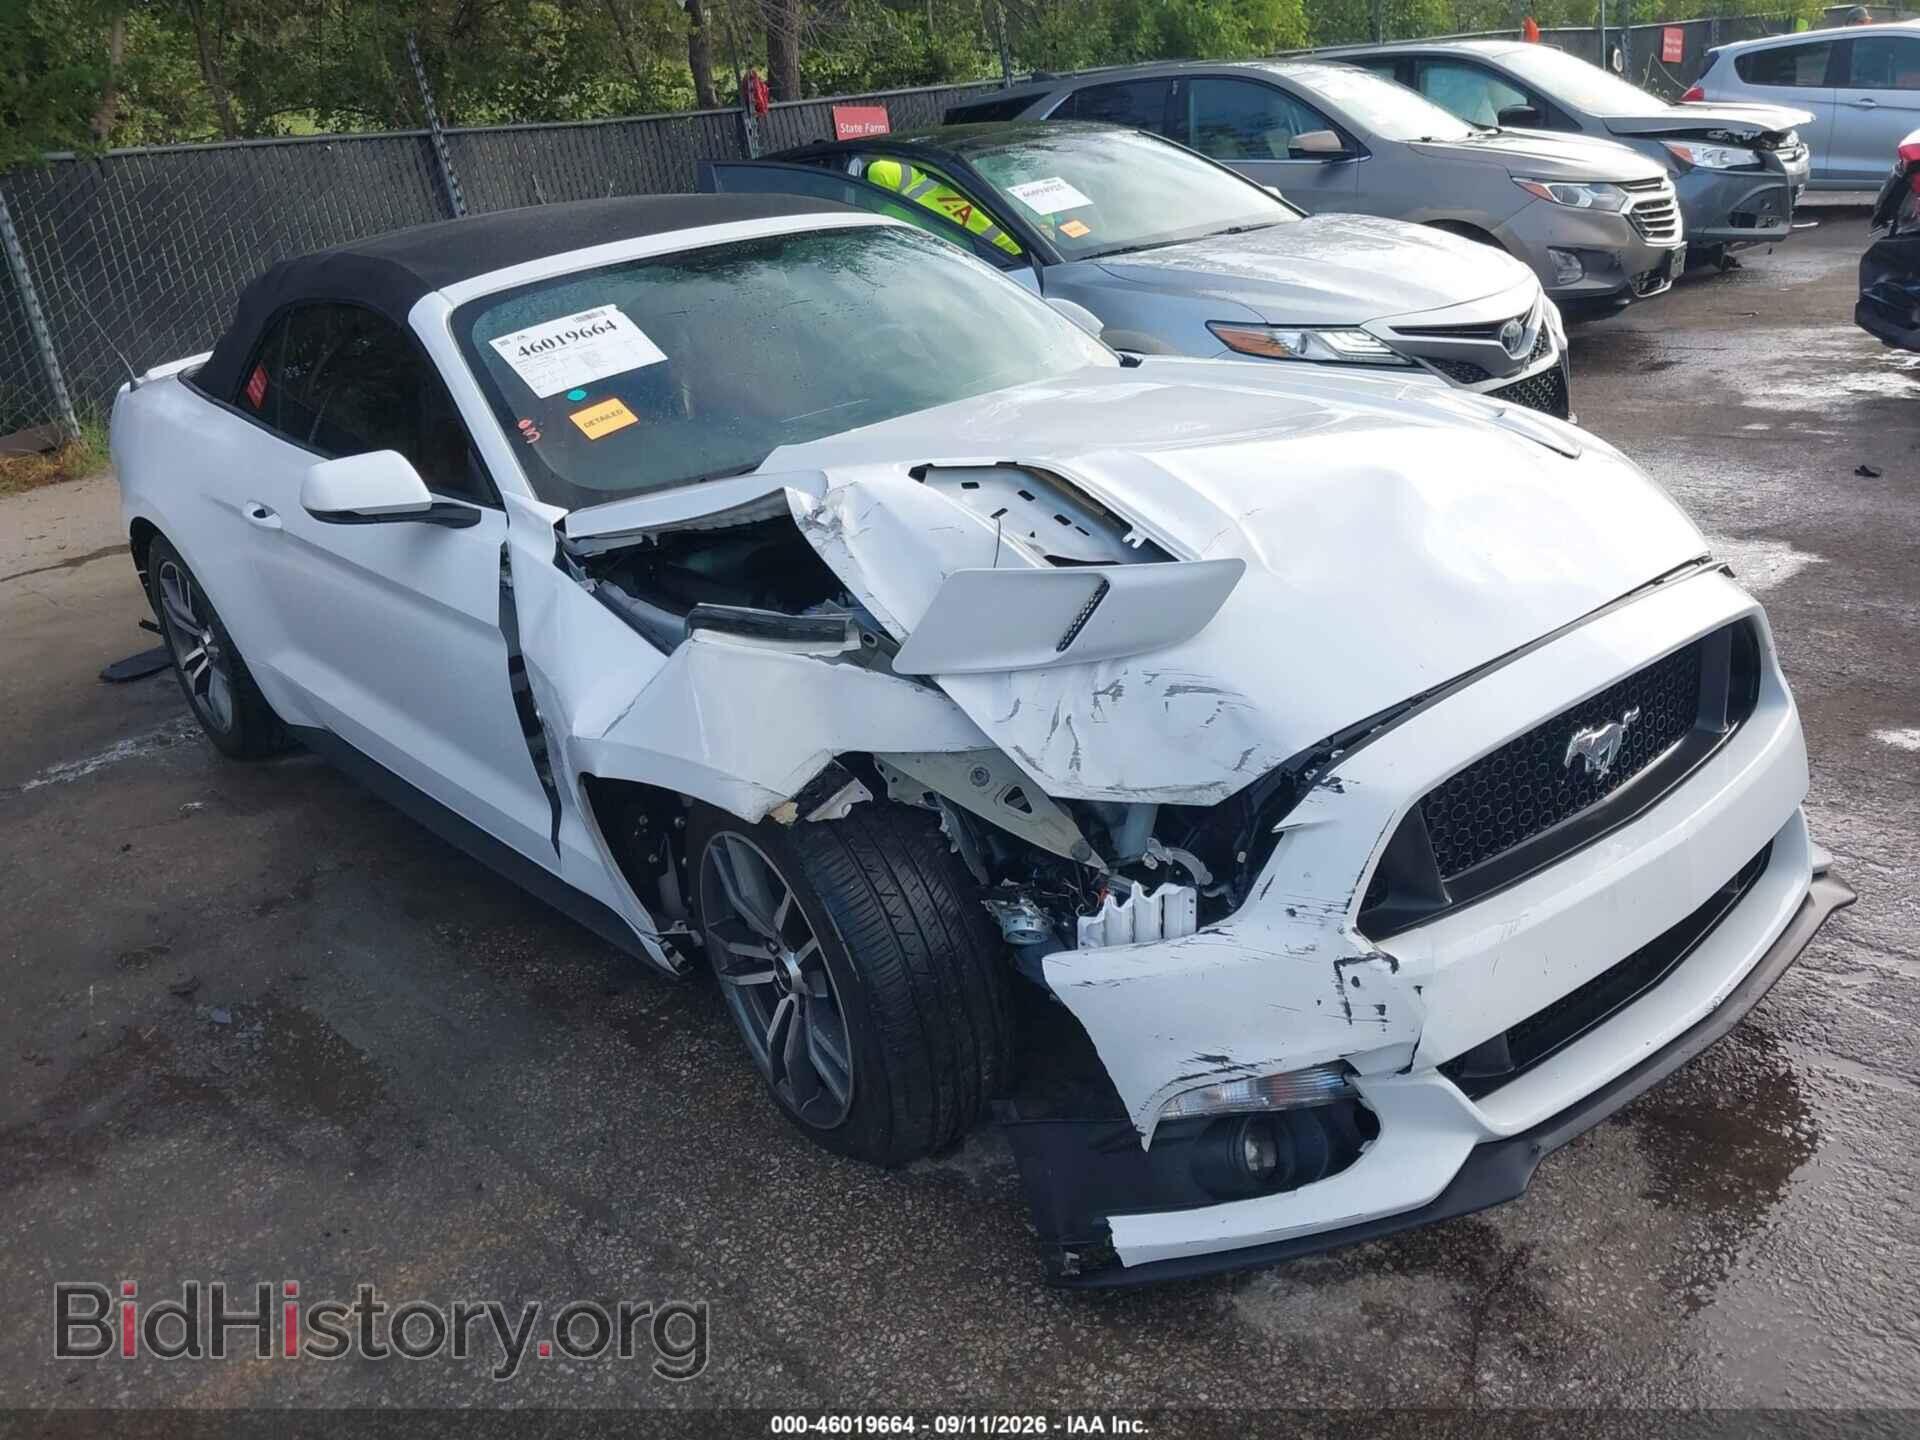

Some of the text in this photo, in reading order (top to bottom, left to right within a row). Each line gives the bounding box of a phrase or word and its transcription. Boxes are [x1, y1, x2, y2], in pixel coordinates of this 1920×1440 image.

[840, 122, 886, 133] State Farm
[518, 319, 617, 357] 46019664
[583, 409, 624, 428] DETAILED
